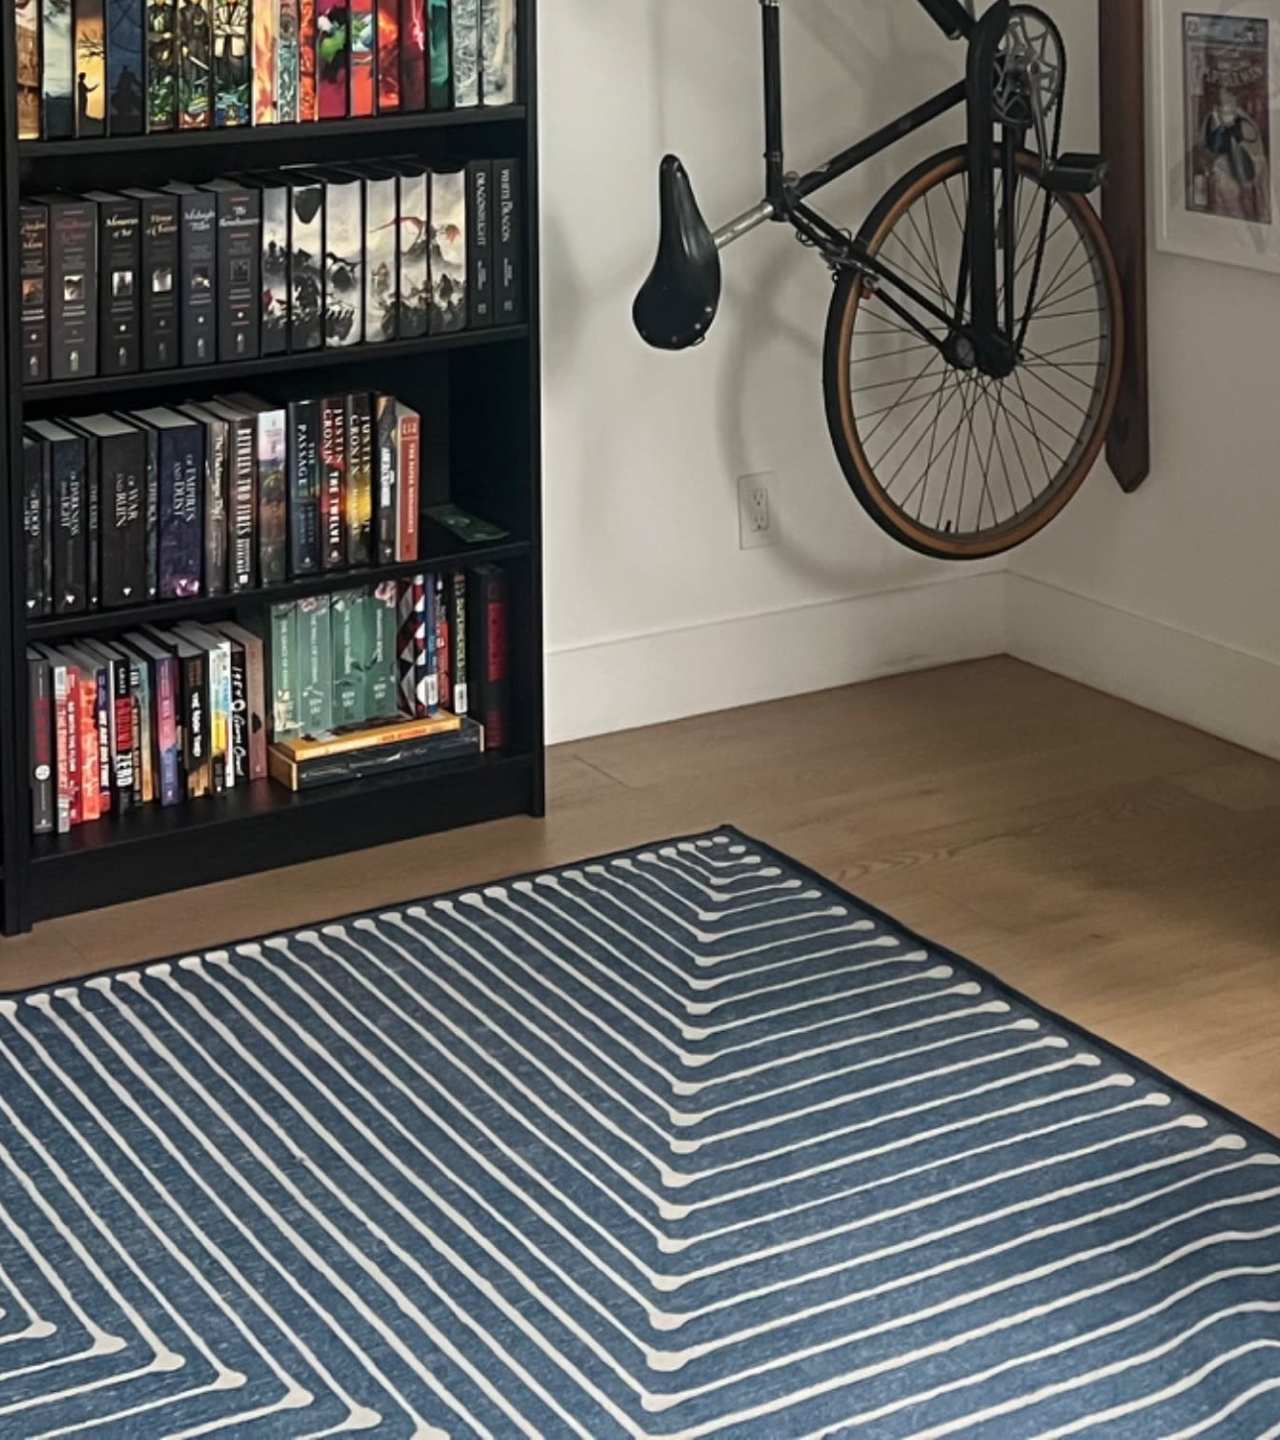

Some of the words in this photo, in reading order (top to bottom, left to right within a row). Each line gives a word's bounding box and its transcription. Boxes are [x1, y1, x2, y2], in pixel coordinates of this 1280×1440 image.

[500, 201, 513, 242] DRAGON
[235, 428, 252, 477] BETWEEN
[297, 424, 308, 486] PASSAGE
[322, 408, 333, 465] CRONIN
[334, 408, 344, 464] JUSTIN
[351, 415, 360, 476] CRONIN
[361, 415, 370, 473] JUSTIN
[173, 481, 185, 517] DUST
[184, 467, 196, 523] EMPIRES
[237, 479, 252, 503] TWO
[329, 471, 339, 494] THE
[115, 492, 127, 527] RUIN
[126, 488, 139, 521] WAR
[237, 505, 252, 536] FIRES
[329, 498, 340, 544] TWELVE
[191, 693, 199, 709] THE
[115, 698, 130, 751] GROUND
[192, 711, 201, 734] BOOK
[232, 714, 245, 744] George
[116, 753, 132, 787] ZERO
